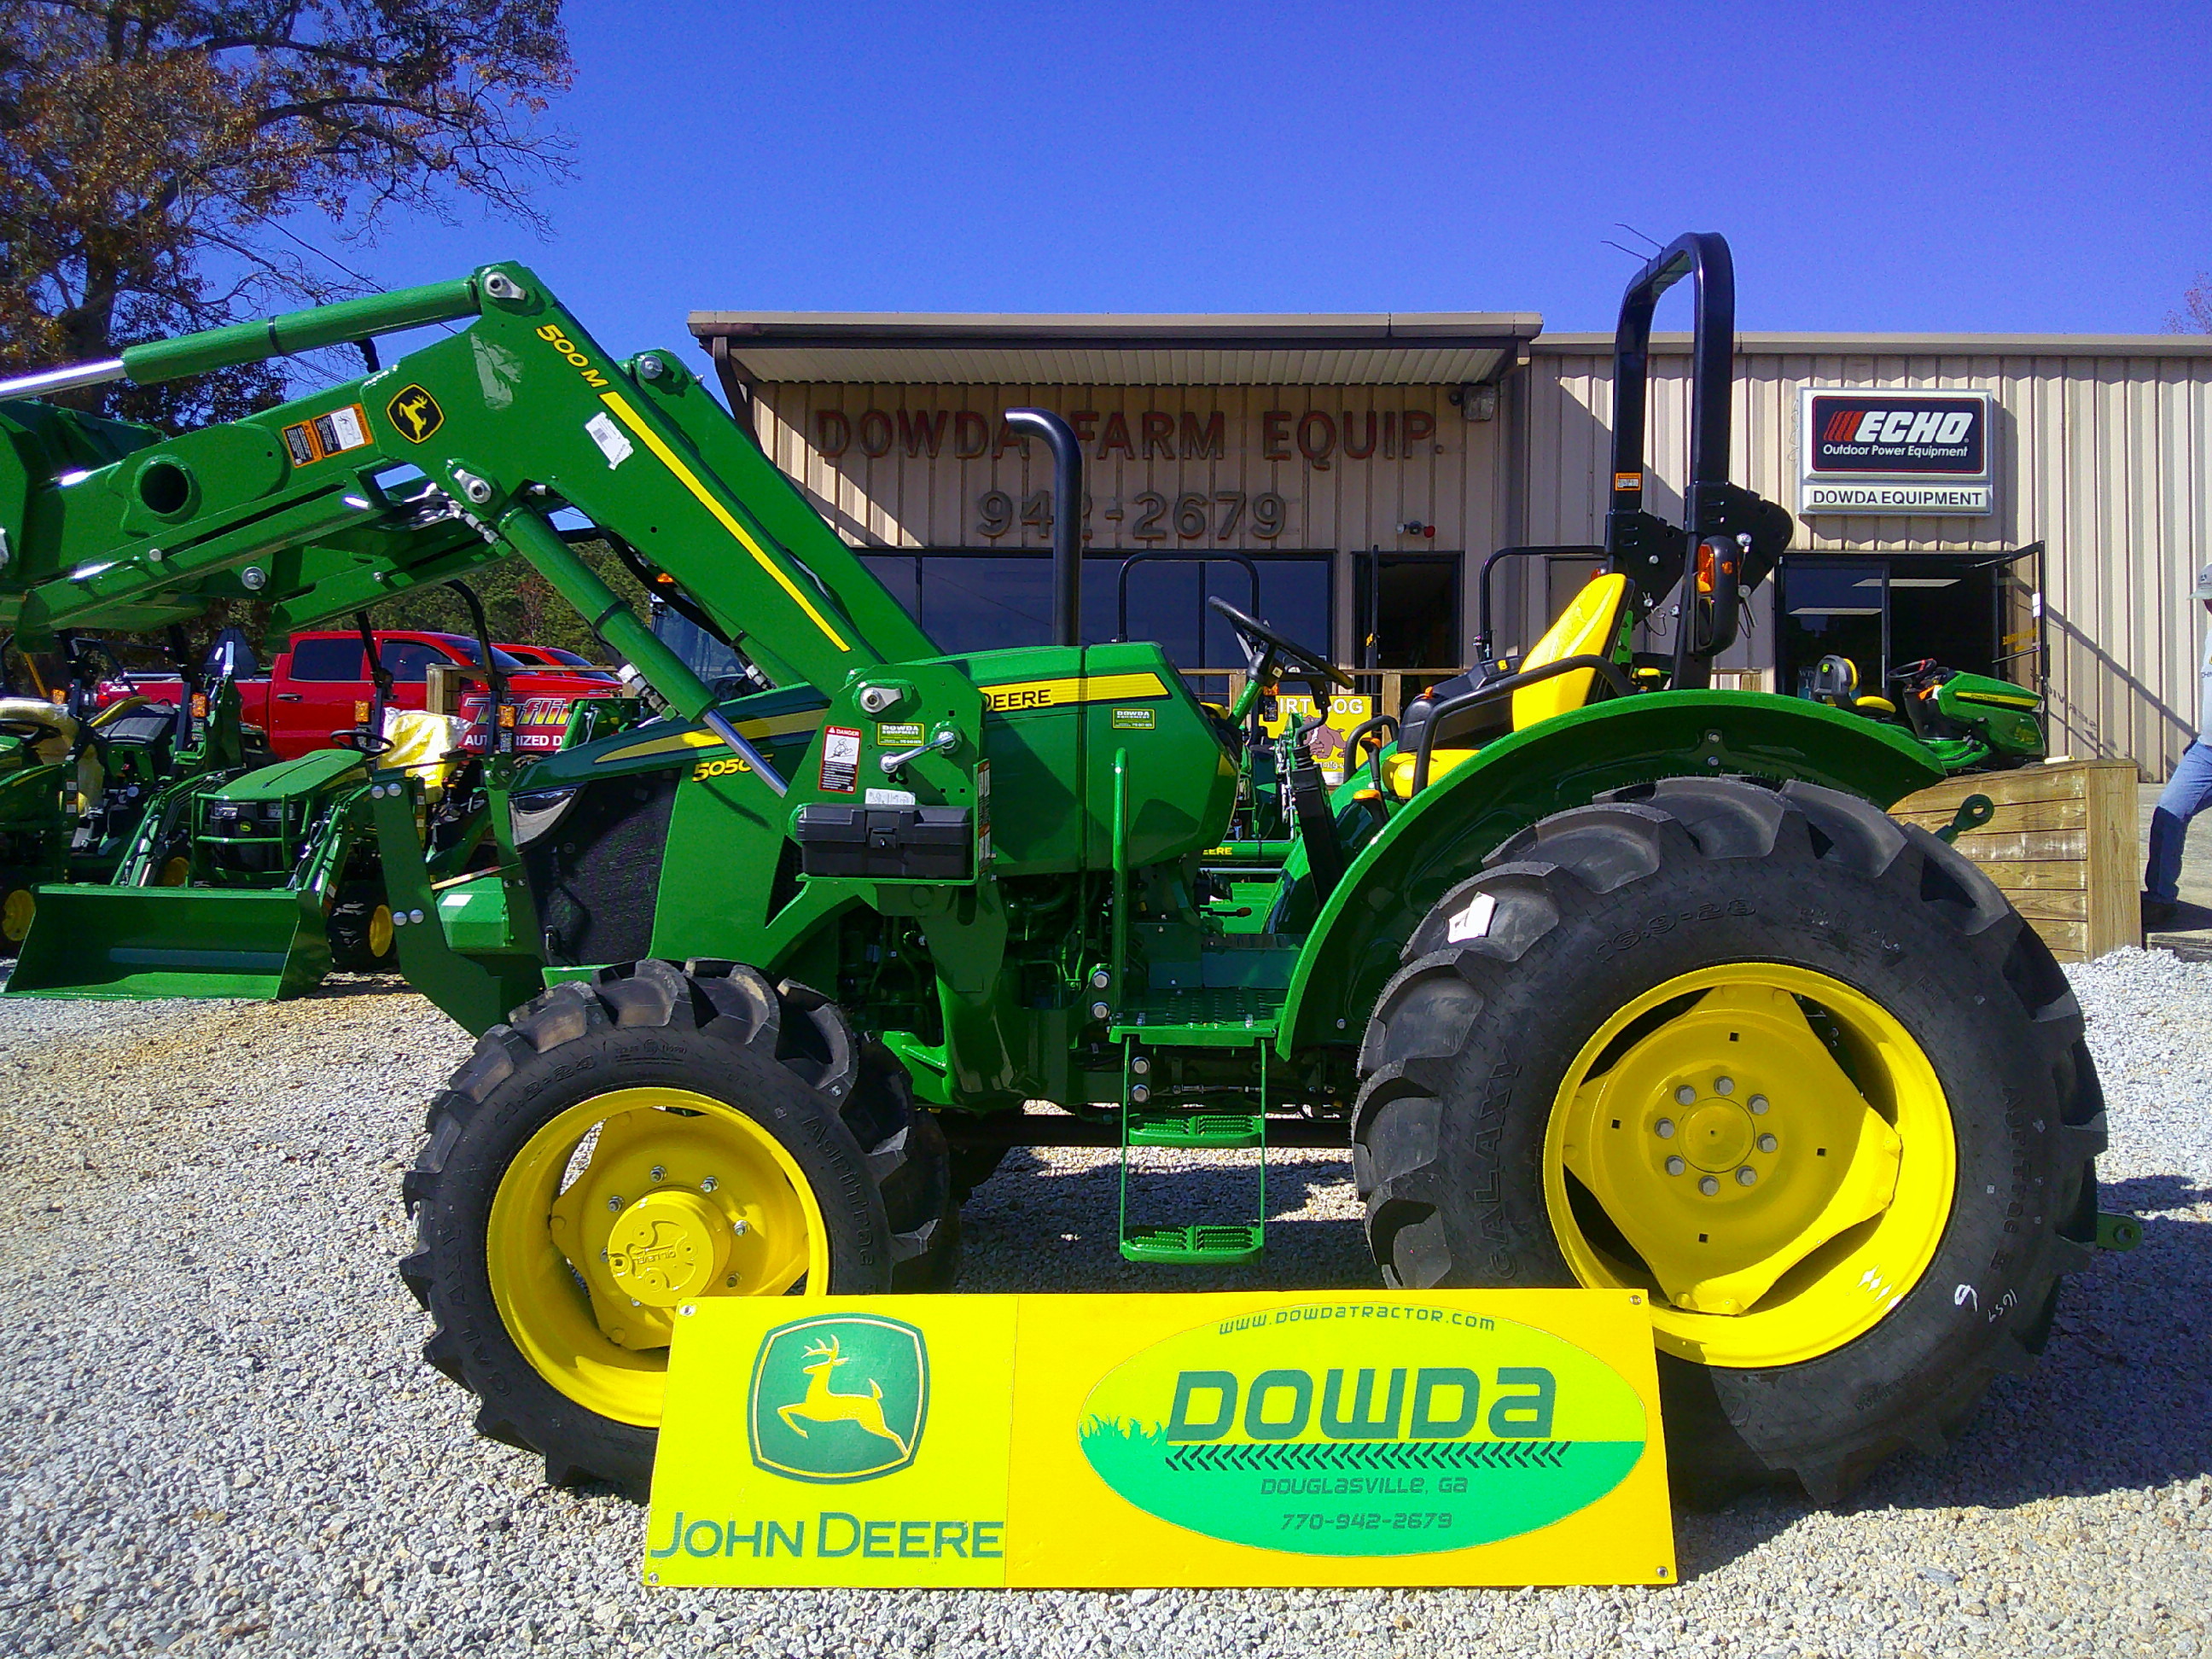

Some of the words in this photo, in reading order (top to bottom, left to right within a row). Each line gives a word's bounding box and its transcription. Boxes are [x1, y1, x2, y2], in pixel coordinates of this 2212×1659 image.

[1855, 410, 1974, 444] ECHO
[816, 409, 1031, 460] DOWDA
[1069, 410, 1225, 461] FARM
[1264, 410, 1445, 470] EQUIP.
[1823, 444, 1870, 457] Outdoor
[1871, 445, 1906, 457] Power
[1907, 445, 1968, 459] Equipment
[1813, 490, 1878, 504] DOWDA
[1881, 491, 1982, 506] EQUIPMENT
[1278, 696, 1313, 715] IRT
[1318, 697, 1364, 714] OG
[463, 734, 550, 747] AUIZED
[835, 728, 860, 737] DANGER
[1202, 846, 1233, 856] EERE
[1279, 1511, 1453, 1531] 770-942-2679
[649, 1511, 805, 1559] JOHN
[817, 1511, 1004, 1559] DEERE
